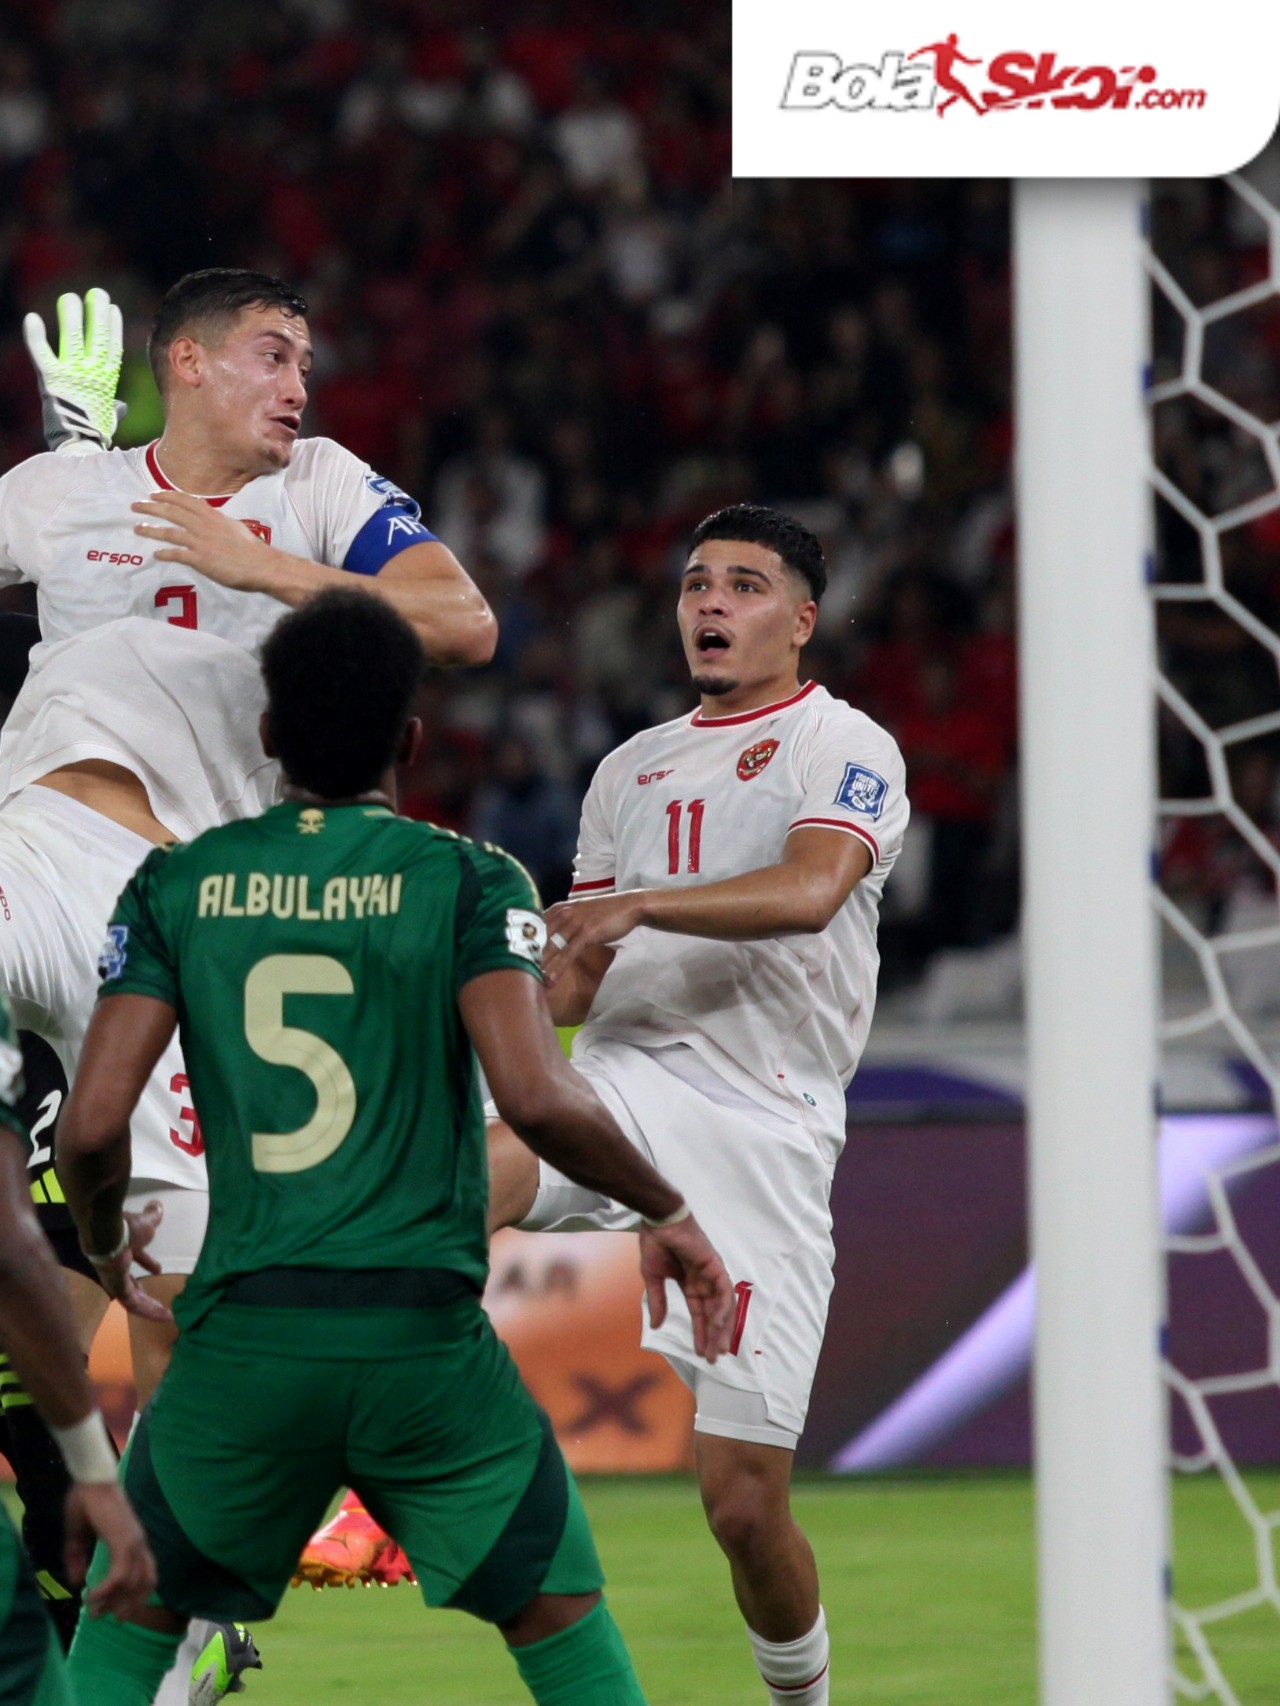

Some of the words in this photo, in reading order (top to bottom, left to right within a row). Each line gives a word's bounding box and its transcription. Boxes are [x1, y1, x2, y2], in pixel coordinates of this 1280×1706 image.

[86, 548, 144, 567] erspo
[387, 515, 422, 546] AF
[666, 799, 705, 875] 11
[198, 873, 402, 921] ALBULAYHI
[244, 953, 357, 1173] 5
[169, 1072, 206, 1157] 3
